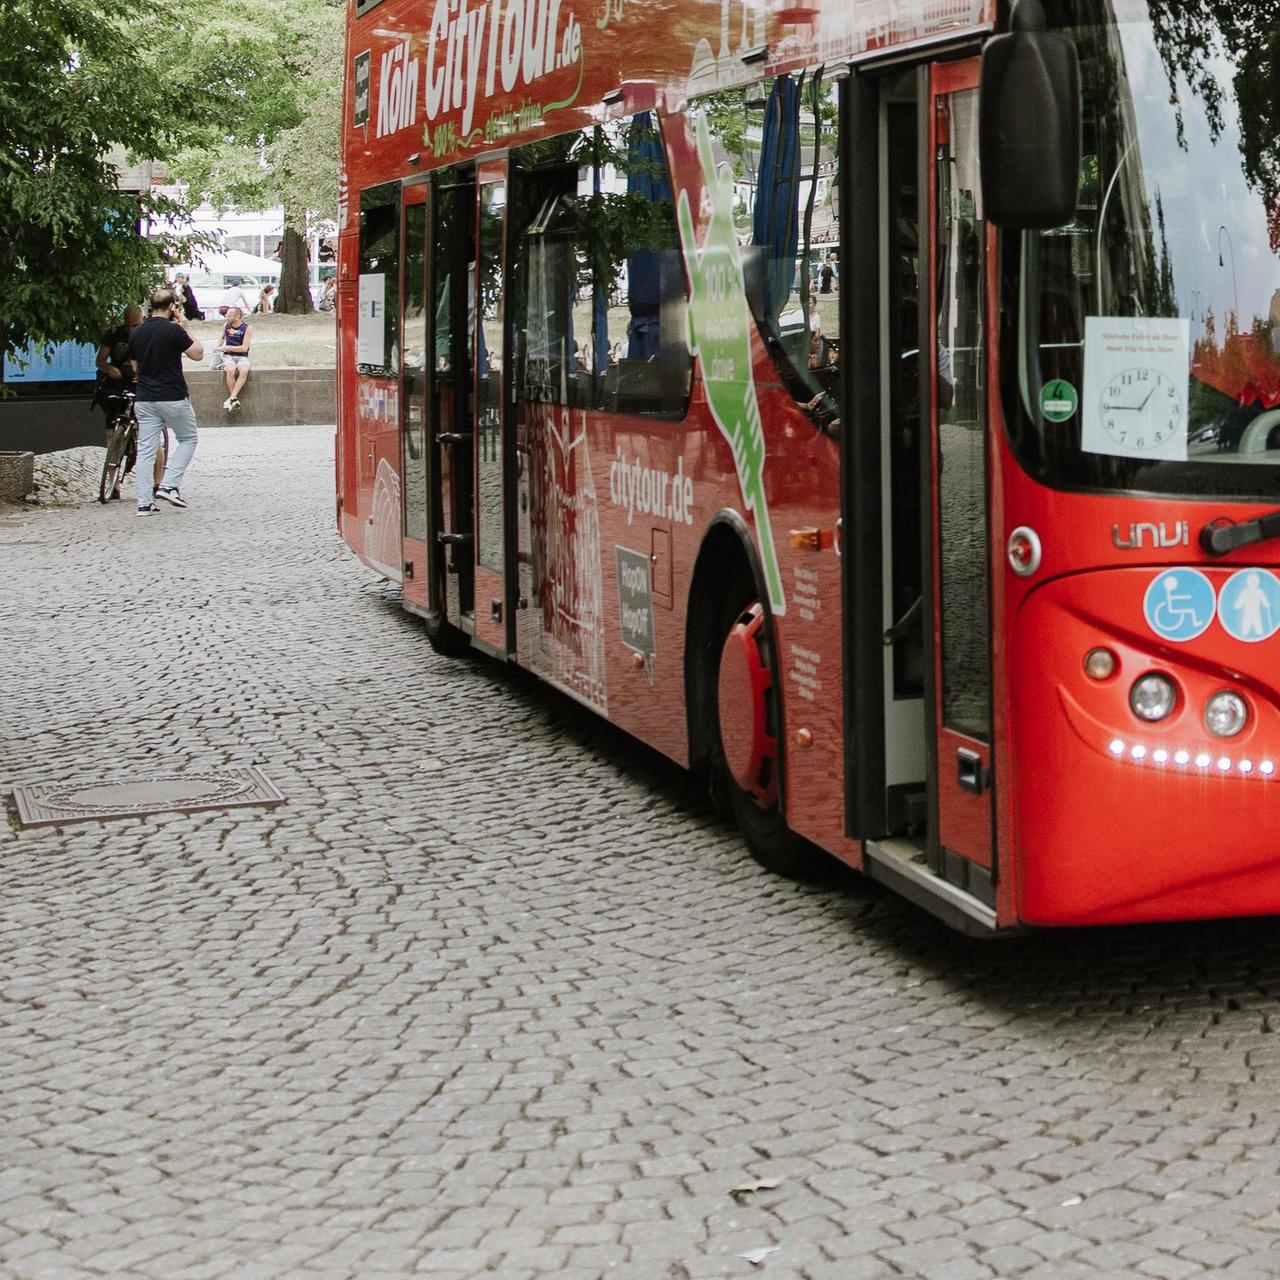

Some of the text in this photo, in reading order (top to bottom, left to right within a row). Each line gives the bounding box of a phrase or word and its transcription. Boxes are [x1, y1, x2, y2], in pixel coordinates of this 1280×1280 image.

[376, 39, 419, 139] Köln
[1120, 374, 1132, 385] 11
[1136, 370, 1149, 381] 12
[1156, 375, 1162, 386] 1
[1052, 382, 1064, 400] 4
[1109, 386, 1121, 397] 10
[1167, 388, 1175, 398] 2
[1172, 405, 1179, 414] 3
[1108, 420, 1115, 429] 8
[1167, 420, 1174, 430] 4
[1120, 431, 1127, 442] 7
[1154, 432, 1162, 443] 5
[1137, 437, 1144, 448] 6
[610, 445, 694, 526] citytour.de
